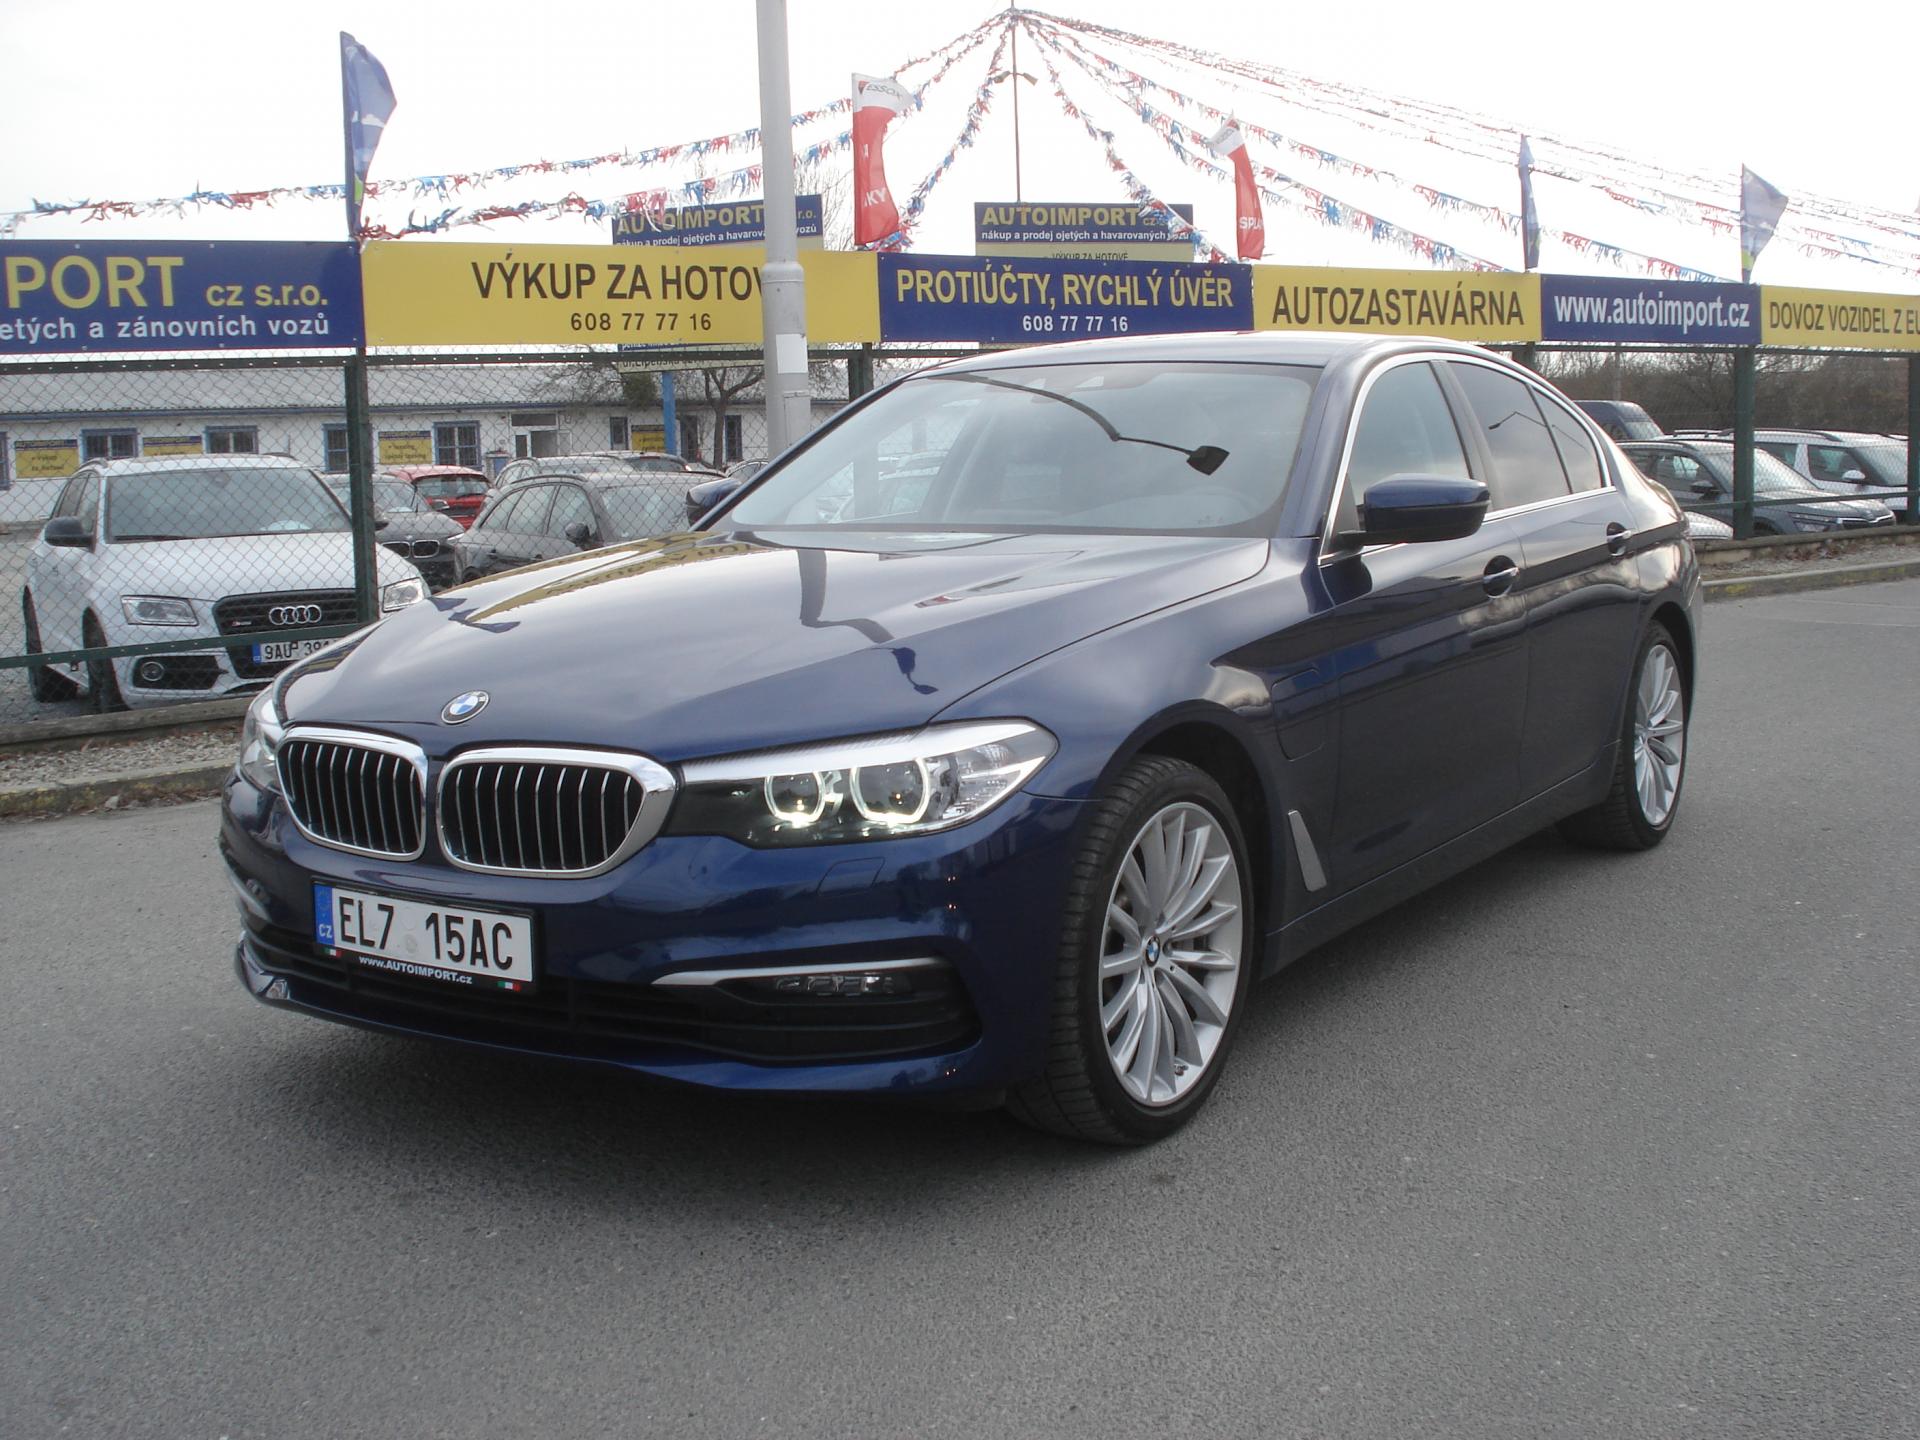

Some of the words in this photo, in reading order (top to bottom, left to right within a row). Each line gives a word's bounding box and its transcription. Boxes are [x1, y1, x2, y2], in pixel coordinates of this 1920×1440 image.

[981, 207, 1140, 226] AUTOIMPORT
[653, 234, 680, 247] prodej
[683, 231, 716, 246] ojetých
[981, 231, 1012, 241] nákup
[1023, 230, 1053, 242] prodej
[1056, 230, 1090, 242] ojetých
[1101, 230, 1166, 242] havarovaných
[5, 256, 184, 309] PORT
[206, 284, 243, 306] cz
[255, 283, 328, 306] s.r.o.
[471, 253, 596, 299] VÝKUP
[607, 264, 652, 299] ZA
[897, 264, 1056, 310] PROTIÚČTY,
[1064, 270, 1161, 306] RYCHLÝ
[1169, 266, 1233, 307] ÚVĚR
[1272, 281, 1524, 326] AUTOZASTAVÁRNA
[1554, 291, 1750, 334] www.autoimport.cz
[1770, 300, 1824, 331] DOVOZ
[1830, 304, 1890, 334] VOZIDEL
[1893, 308, 1903, 334] Z
[0, 317, 76, 345] etých
[89, 321, 105, 338] a
[118, 315, 257, 338] zánovních
[267, 313, 329, 336] vozů
[571, 313, 611, 331] 608
[622, 313, 644, 331] 77
[655, 313, 677, 331] 77
[689, 313, 712, 331] 16
[1022, 315, 1053, 332] 608
[1060, 315, 1078, 332] 77
[1086, 316, 1103, 332] 77
[1111, 316, 1129, 332] 16
[319, 924, 332, 938] CZ
[339, 896, 394, 950] EL7
[425, 912, 513, 970] 15AC
[359, 955, 473, 984] www.AUTOIMPORT.cz
